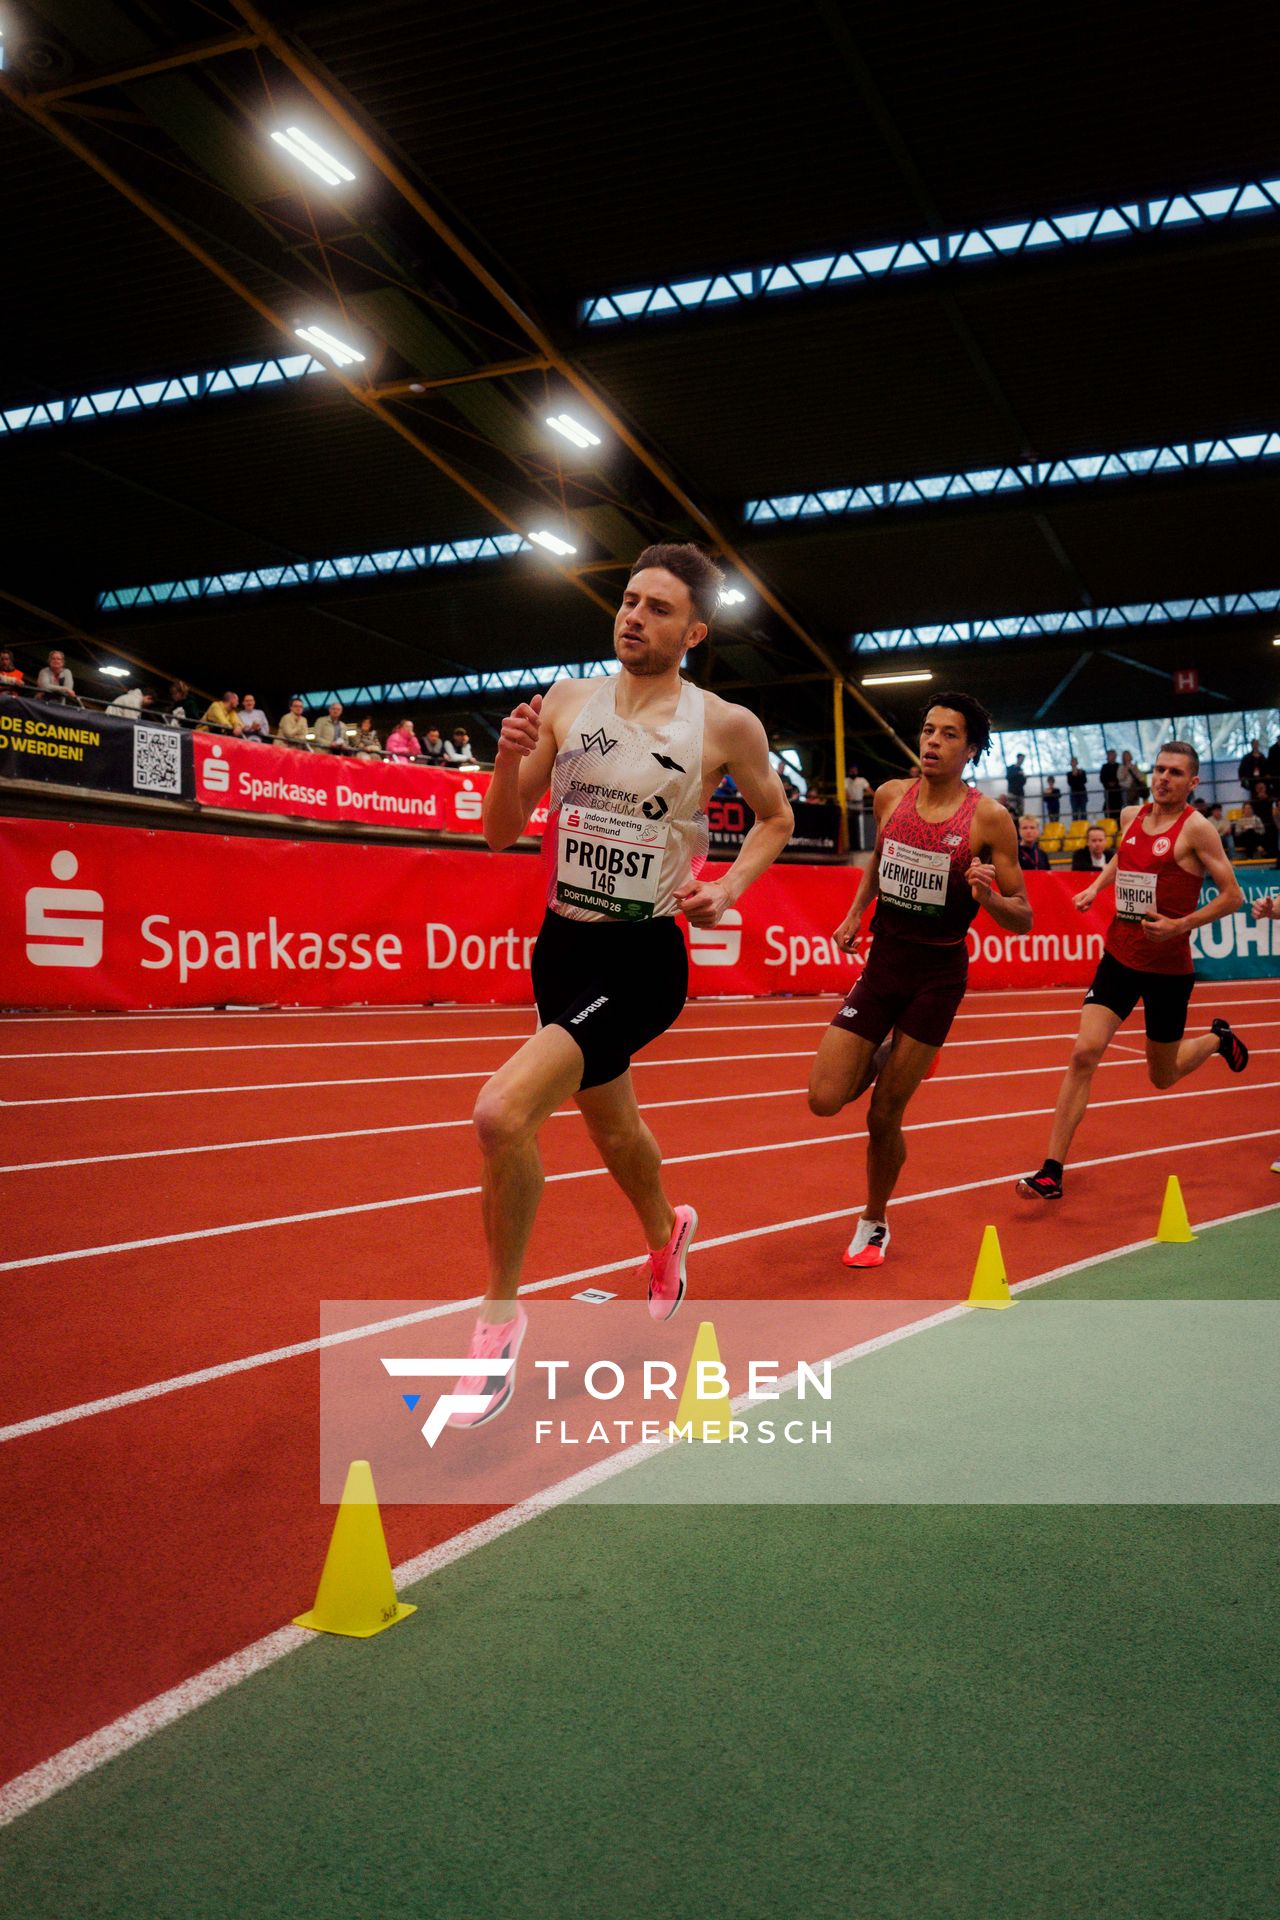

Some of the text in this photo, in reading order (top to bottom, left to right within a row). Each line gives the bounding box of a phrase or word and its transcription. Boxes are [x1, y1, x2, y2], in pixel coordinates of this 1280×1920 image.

[1179, 672, 1194, 689] H
[0, 716, 100, 747] DE SCANNEN
[11, 737, 84, 761] WERDEN!
[238, 772, 437, 816] Sparkasse Dortmund
[570, 781, 639, 804] STADTWERKE
[590, 799, 636, 817] BOCHUM
[583, 822, 621, 836] Dortmund
[584, 812, 643, 831] Indoor Meeting
[565, 838, 655, 880] PROBST
[590, 870, 616, 896] 146
[882, 860, 944, 892] VERMEULEN
[564, 888, 609, 909] DORTMUND
[609, 902, 622, 913] 26
[898, 883, 918, 901] 198
[1118, 886, 1153, 905] INRICH
[1124, 901, 1135, 913] 75
[140, 914, 403, 983] Sparkasse
[570, 995, 609, 1025] KIPRUN
